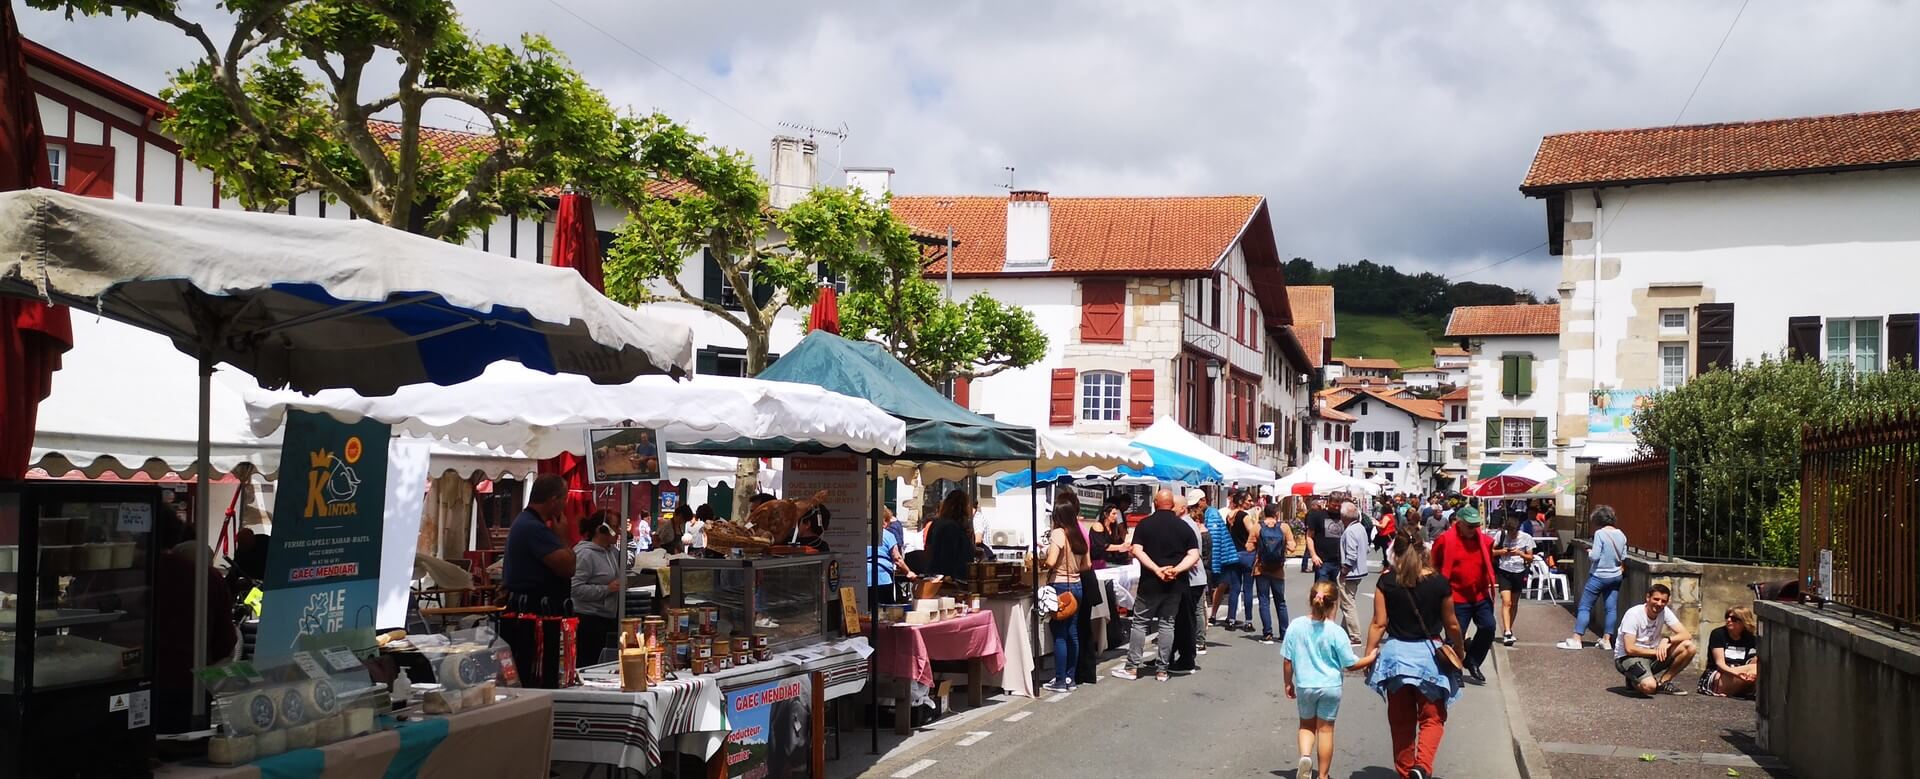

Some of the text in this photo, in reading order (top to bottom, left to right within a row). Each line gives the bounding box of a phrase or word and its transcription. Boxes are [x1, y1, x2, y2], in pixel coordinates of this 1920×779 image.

[304, 470, 358, 517] KINTOA
[292, 565, 357, 580] GAEC MENDIARI
[329, 589, 347, 612] LE
[735, 682, 801, 712] GAEC MENDIARI
[728, 725, 761, 742] roducteur
